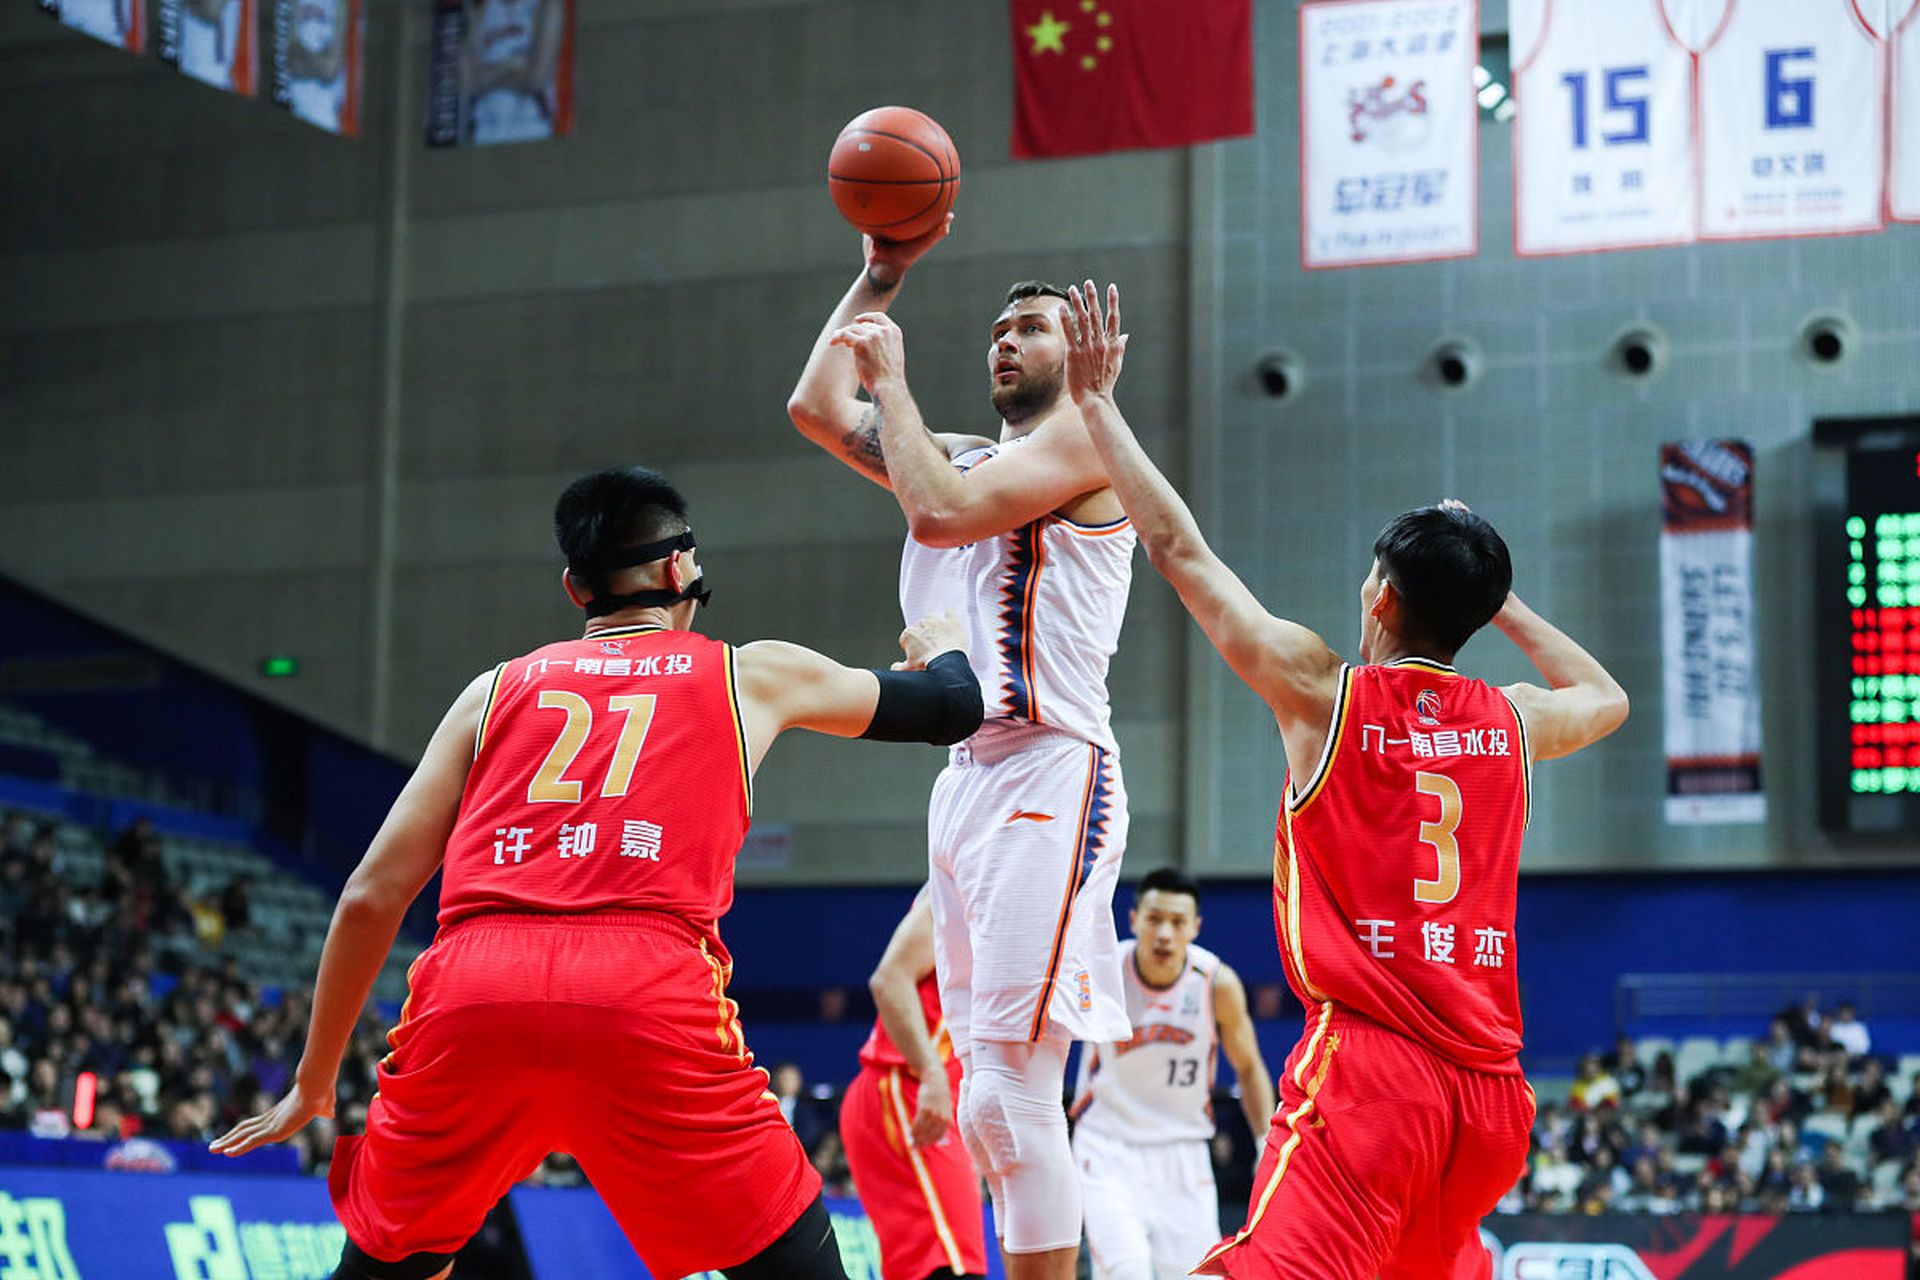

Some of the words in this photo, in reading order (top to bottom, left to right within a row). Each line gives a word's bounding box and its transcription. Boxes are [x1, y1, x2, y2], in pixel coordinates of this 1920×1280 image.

[1560, 65, 1651, 149] 15
[1764, 47, 1817, 130] 6
[526, 690, 657, 804] 27
[493, 819, 664, 865] 许钟豪
[1414, 770, 1463, 904] 3
[1355, 919, 1508, 968] 王俊杰
[1167, 1058, 1199, 1087] 13
